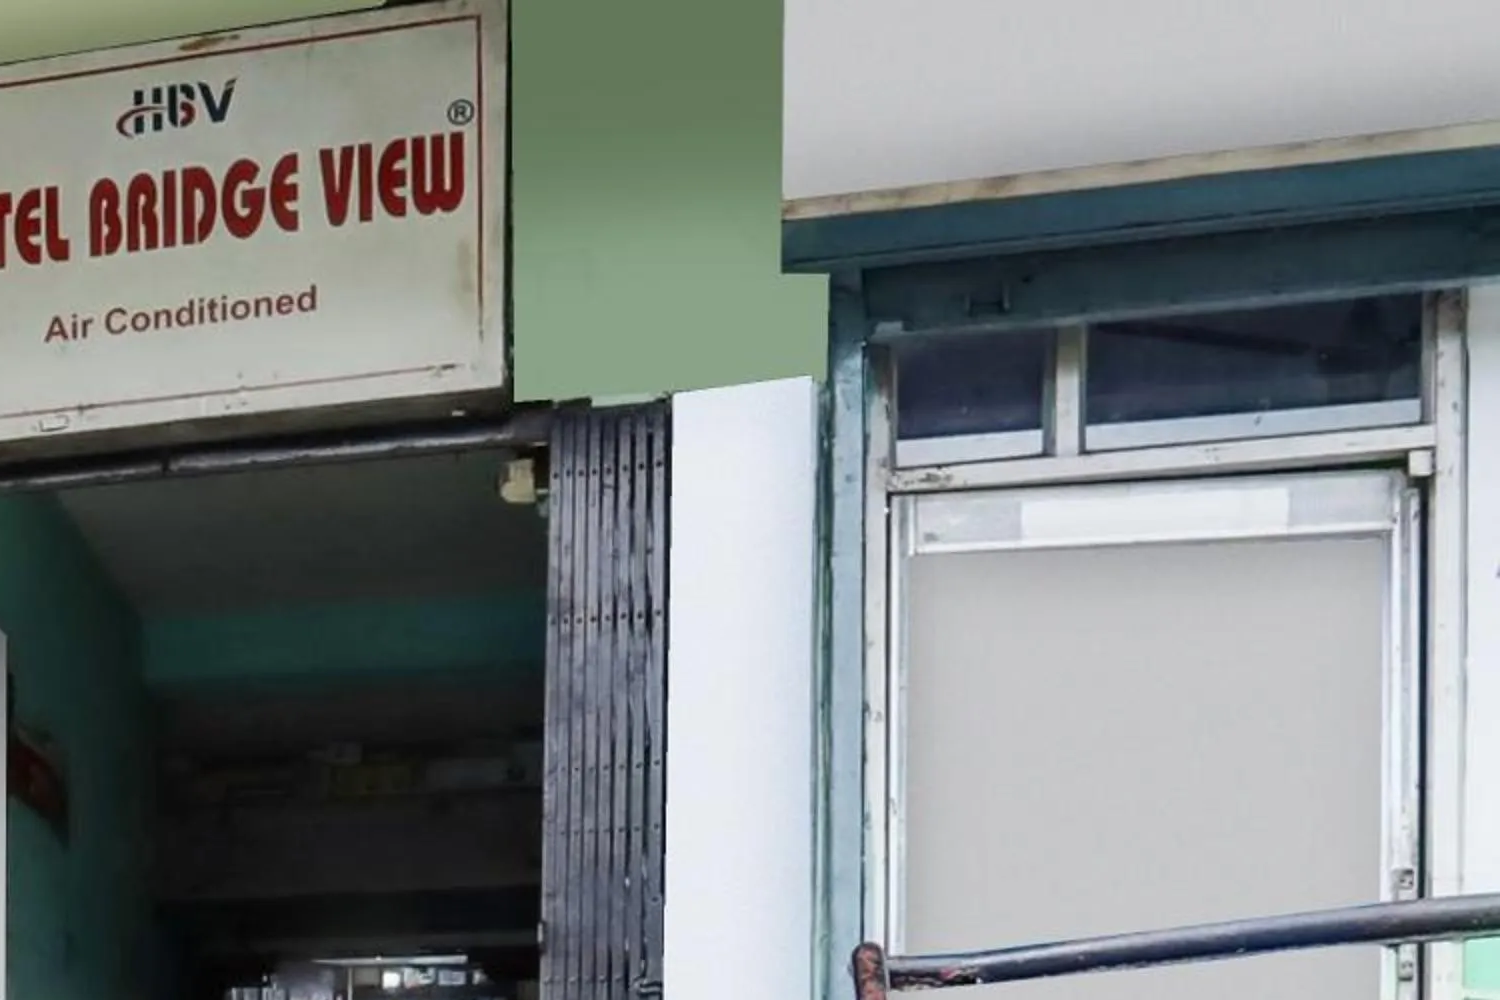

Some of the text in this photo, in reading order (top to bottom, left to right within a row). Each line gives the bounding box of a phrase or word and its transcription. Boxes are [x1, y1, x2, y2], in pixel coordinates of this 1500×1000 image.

[115, 76, 238, 138] HBV
[88, 152, 300, 257] BRIDGE
[319, 132, 466, 227] VIEW
[44, 283, 318, 344] Air Conditioned
